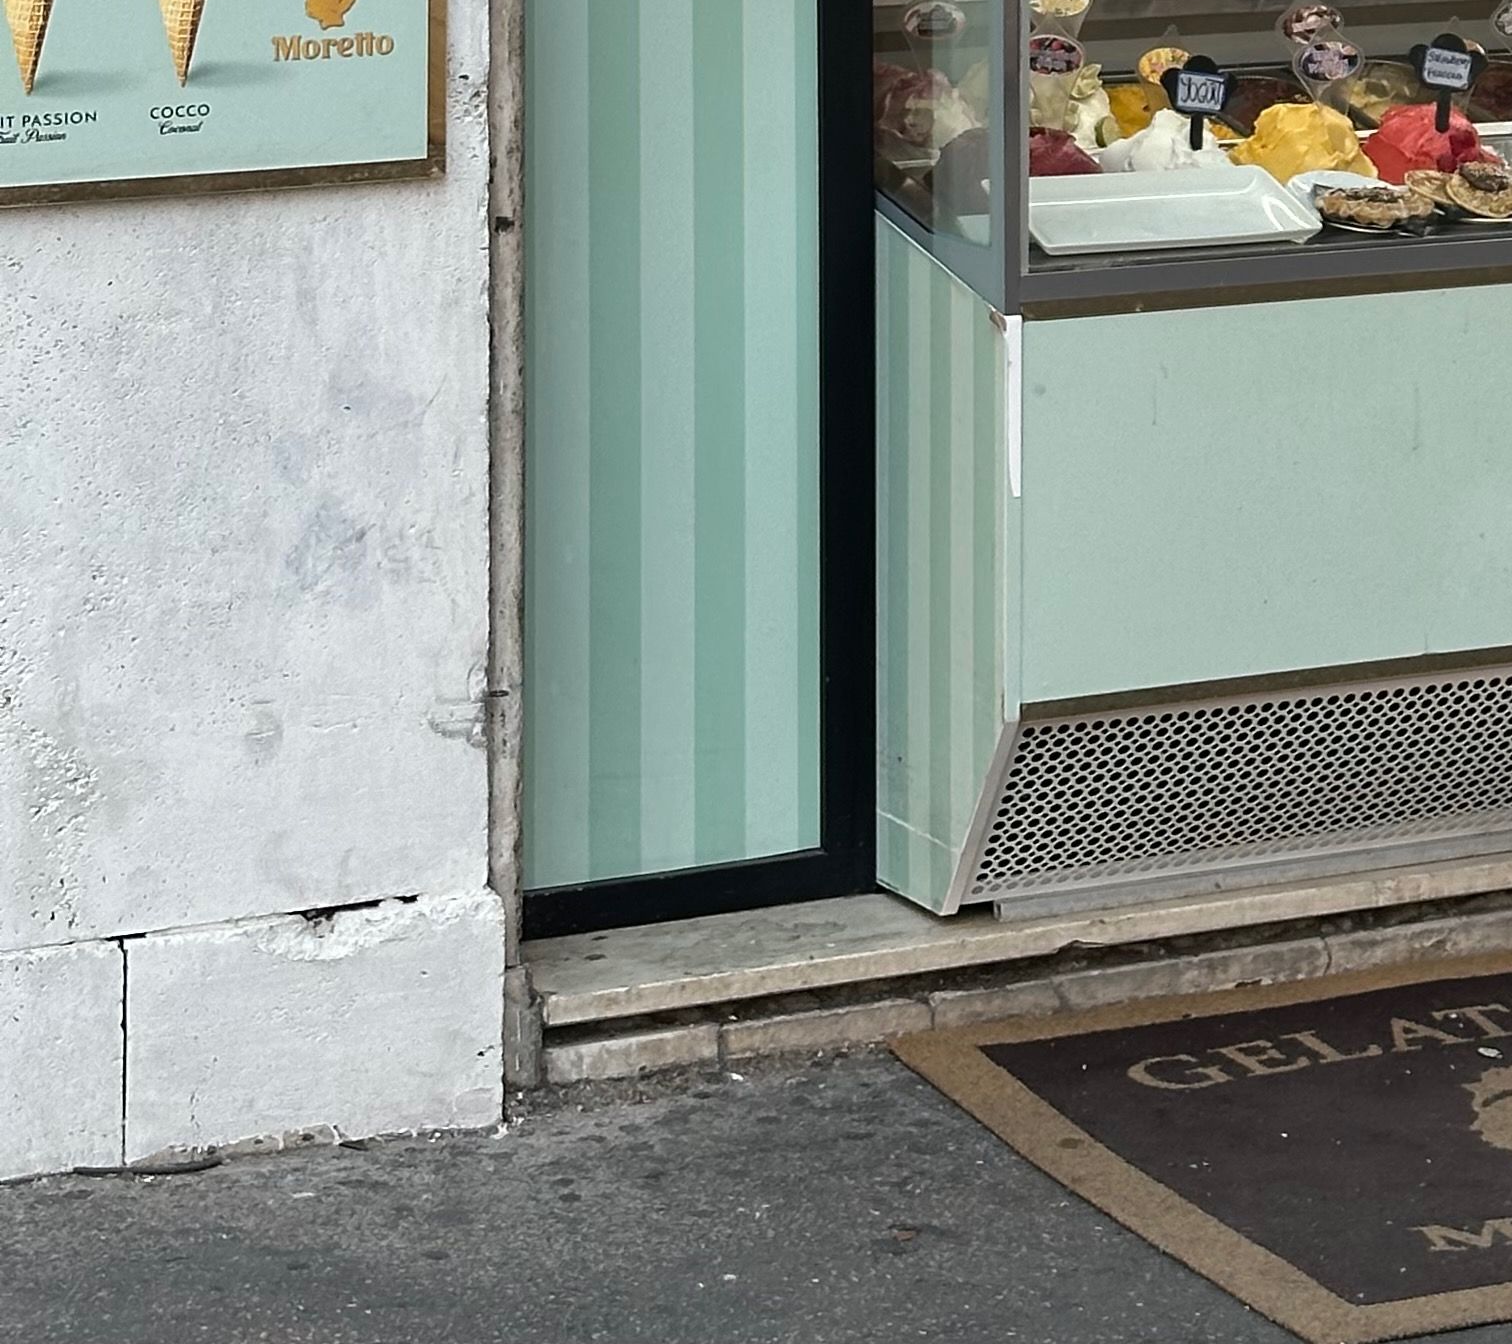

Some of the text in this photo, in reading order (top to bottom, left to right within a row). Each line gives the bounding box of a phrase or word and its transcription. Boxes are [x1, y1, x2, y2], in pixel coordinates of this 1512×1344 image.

[271, 32, 395, 61] Moretto
[22, 111, 97, 128] PASSION
[150, 104, 210, 119] COCCO
